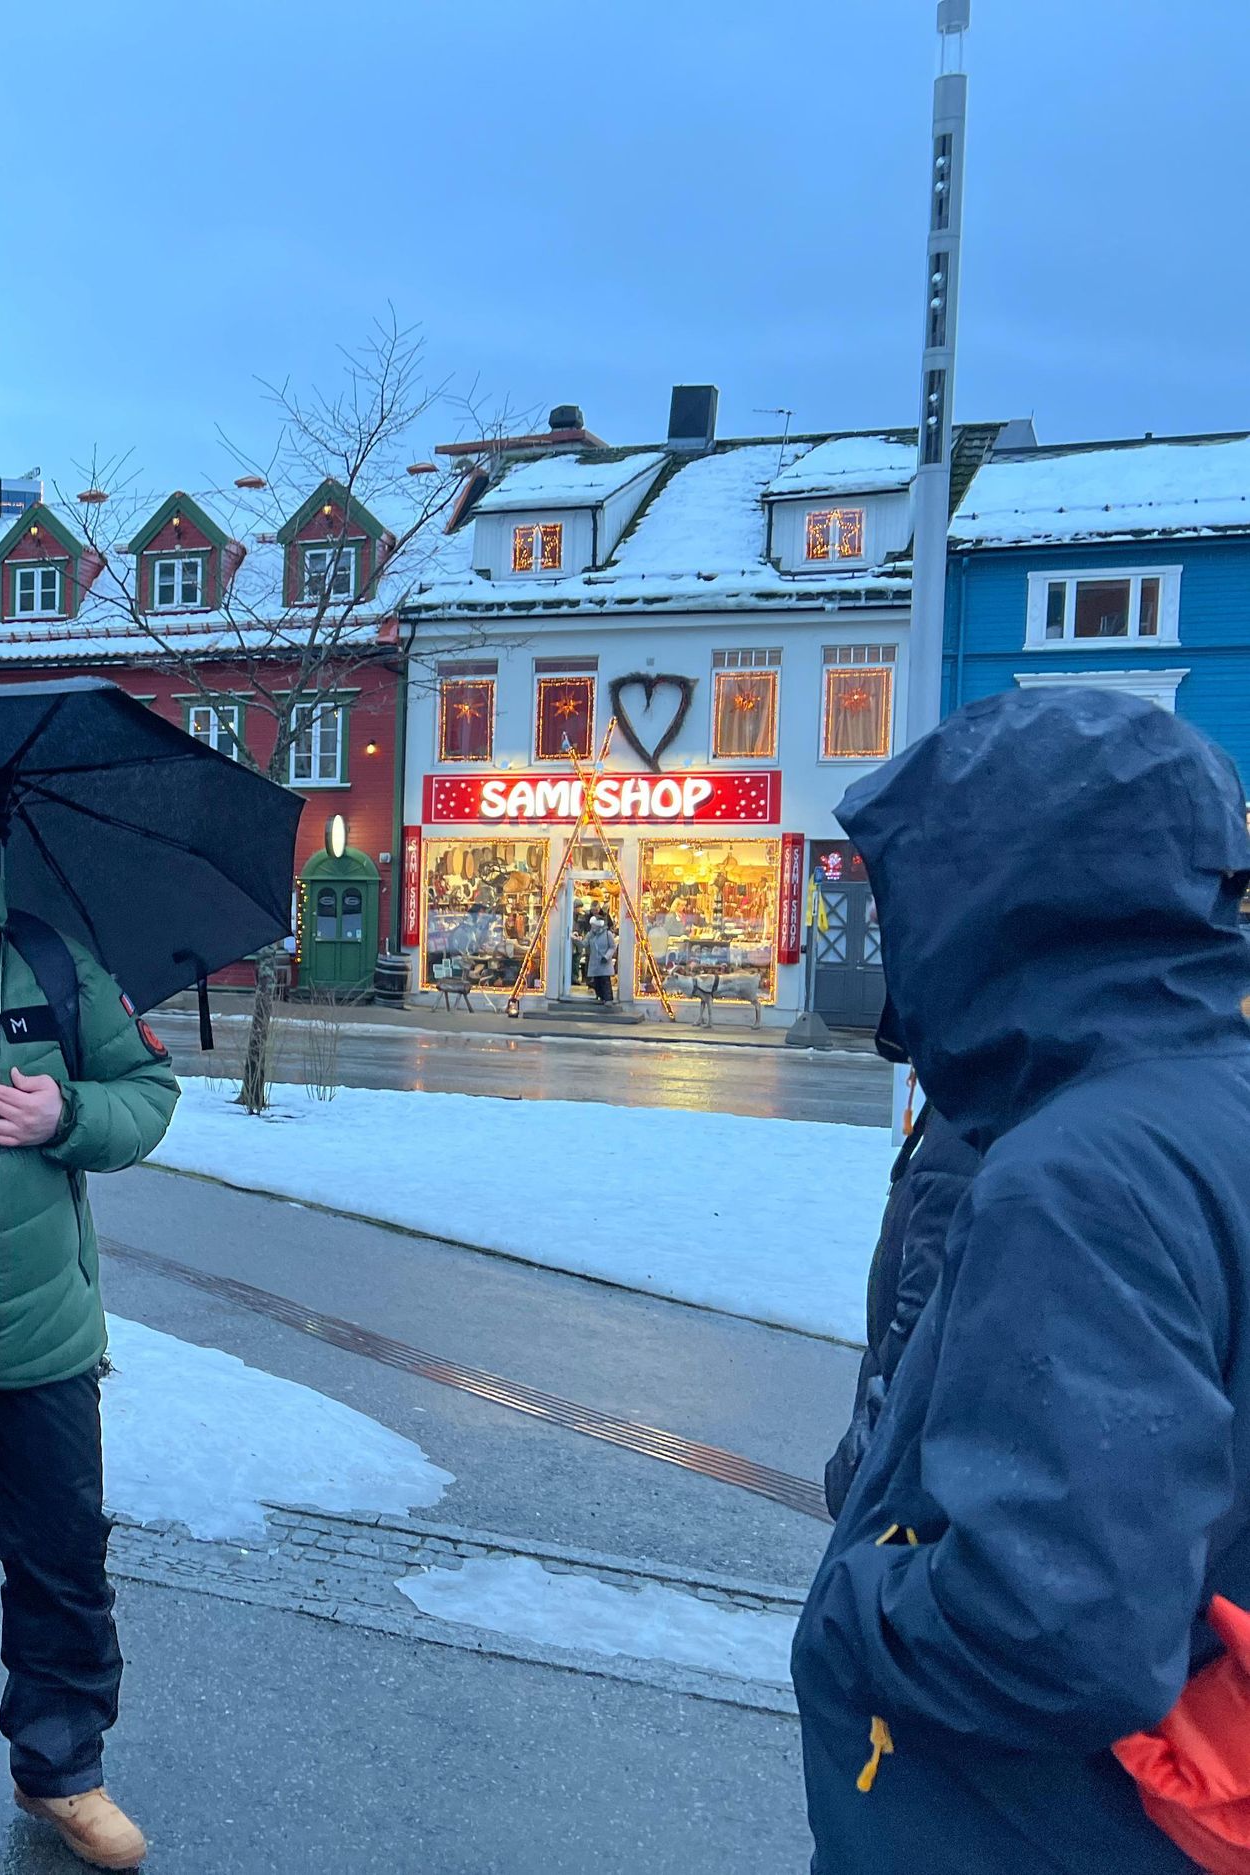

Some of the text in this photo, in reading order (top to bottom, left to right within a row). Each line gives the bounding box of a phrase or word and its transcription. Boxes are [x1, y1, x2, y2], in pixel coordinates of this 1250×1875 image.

[480, 777, 714, 818] SAMI SHOP
[409, 887, 417, 931] SHOP
[790, 900, 798, 948] SHOP
